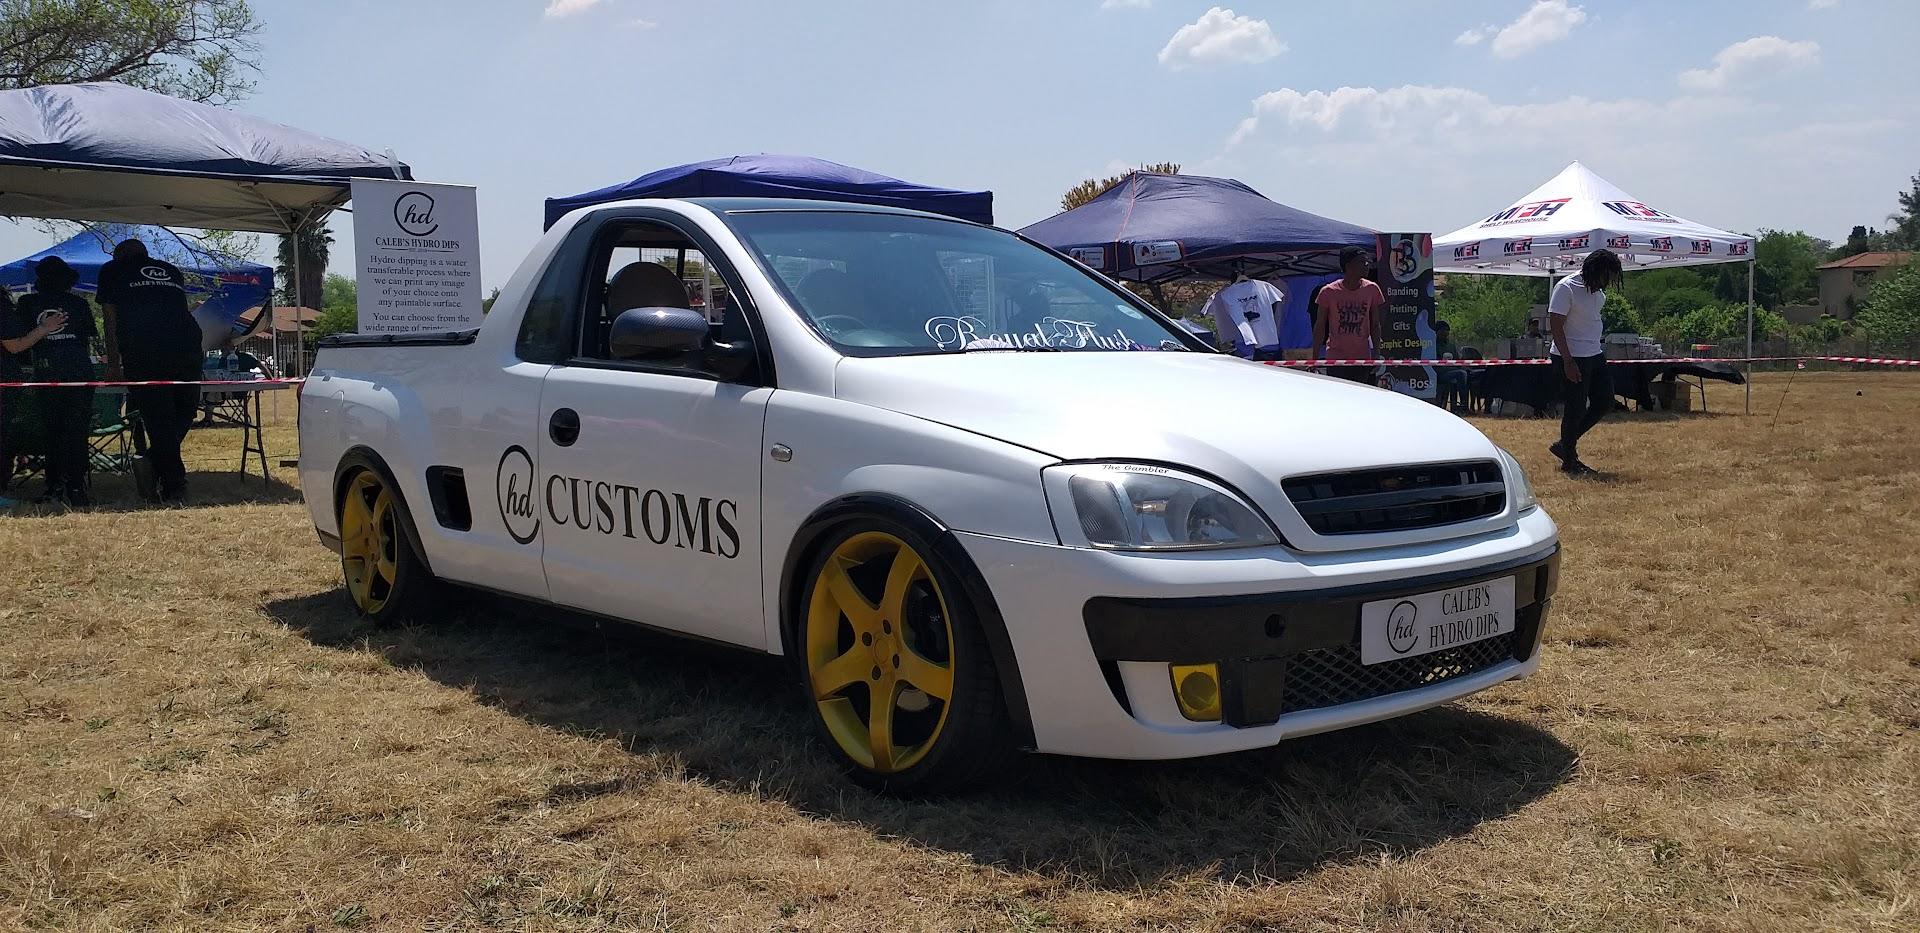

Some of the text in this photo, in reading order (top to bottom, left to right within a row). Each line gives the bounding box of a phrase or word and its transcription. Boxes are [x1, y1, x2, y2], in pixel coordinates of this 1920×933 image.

[1503, 217, 1550, 225] WAREHOUSE
[375, 236, 460, 249] CALEB'S HYDRO DIPS
[370, 255, 396, 266] Hydro
[398, 255, 428, 267] dipping
[429, 257, 437, 266] is
[445, 259, 468, 267] water
[367, 266, 471, 280] transferable process where
[404, 278, 423, 289] print
[425, 280, 439, 288] any
[441, 279, 465, 289] image
[382, 288, 459, 299] of your choice onto
[1387, 286, 1419, 297] Branding
[378, 298, 463, 308] any paintable surface.
[1389, 304, 1418, 315] Printing
[373, 312, 389, 322] You
[407, 313, 434, 322] choose
[436, 313, 456, 322] from
[457, 314, 470, 322] the
[365, 323, 385, 331] wide
[387, 324, 409, 333] range
[411, 323, 421, 331] of
[1393, 321, 1411, 331] Gifts
[1043, 316, 1134, 350] Flush
[1404, 338, 1433, 349] Design
[1124, 465, 1169, 474] Gambler
[546, 475, 741, 560] CUSTOMS
[1442, 585, 1490, 616] CALEB'S
[1428, 611, 1500, 649] HYDRO DIPS
